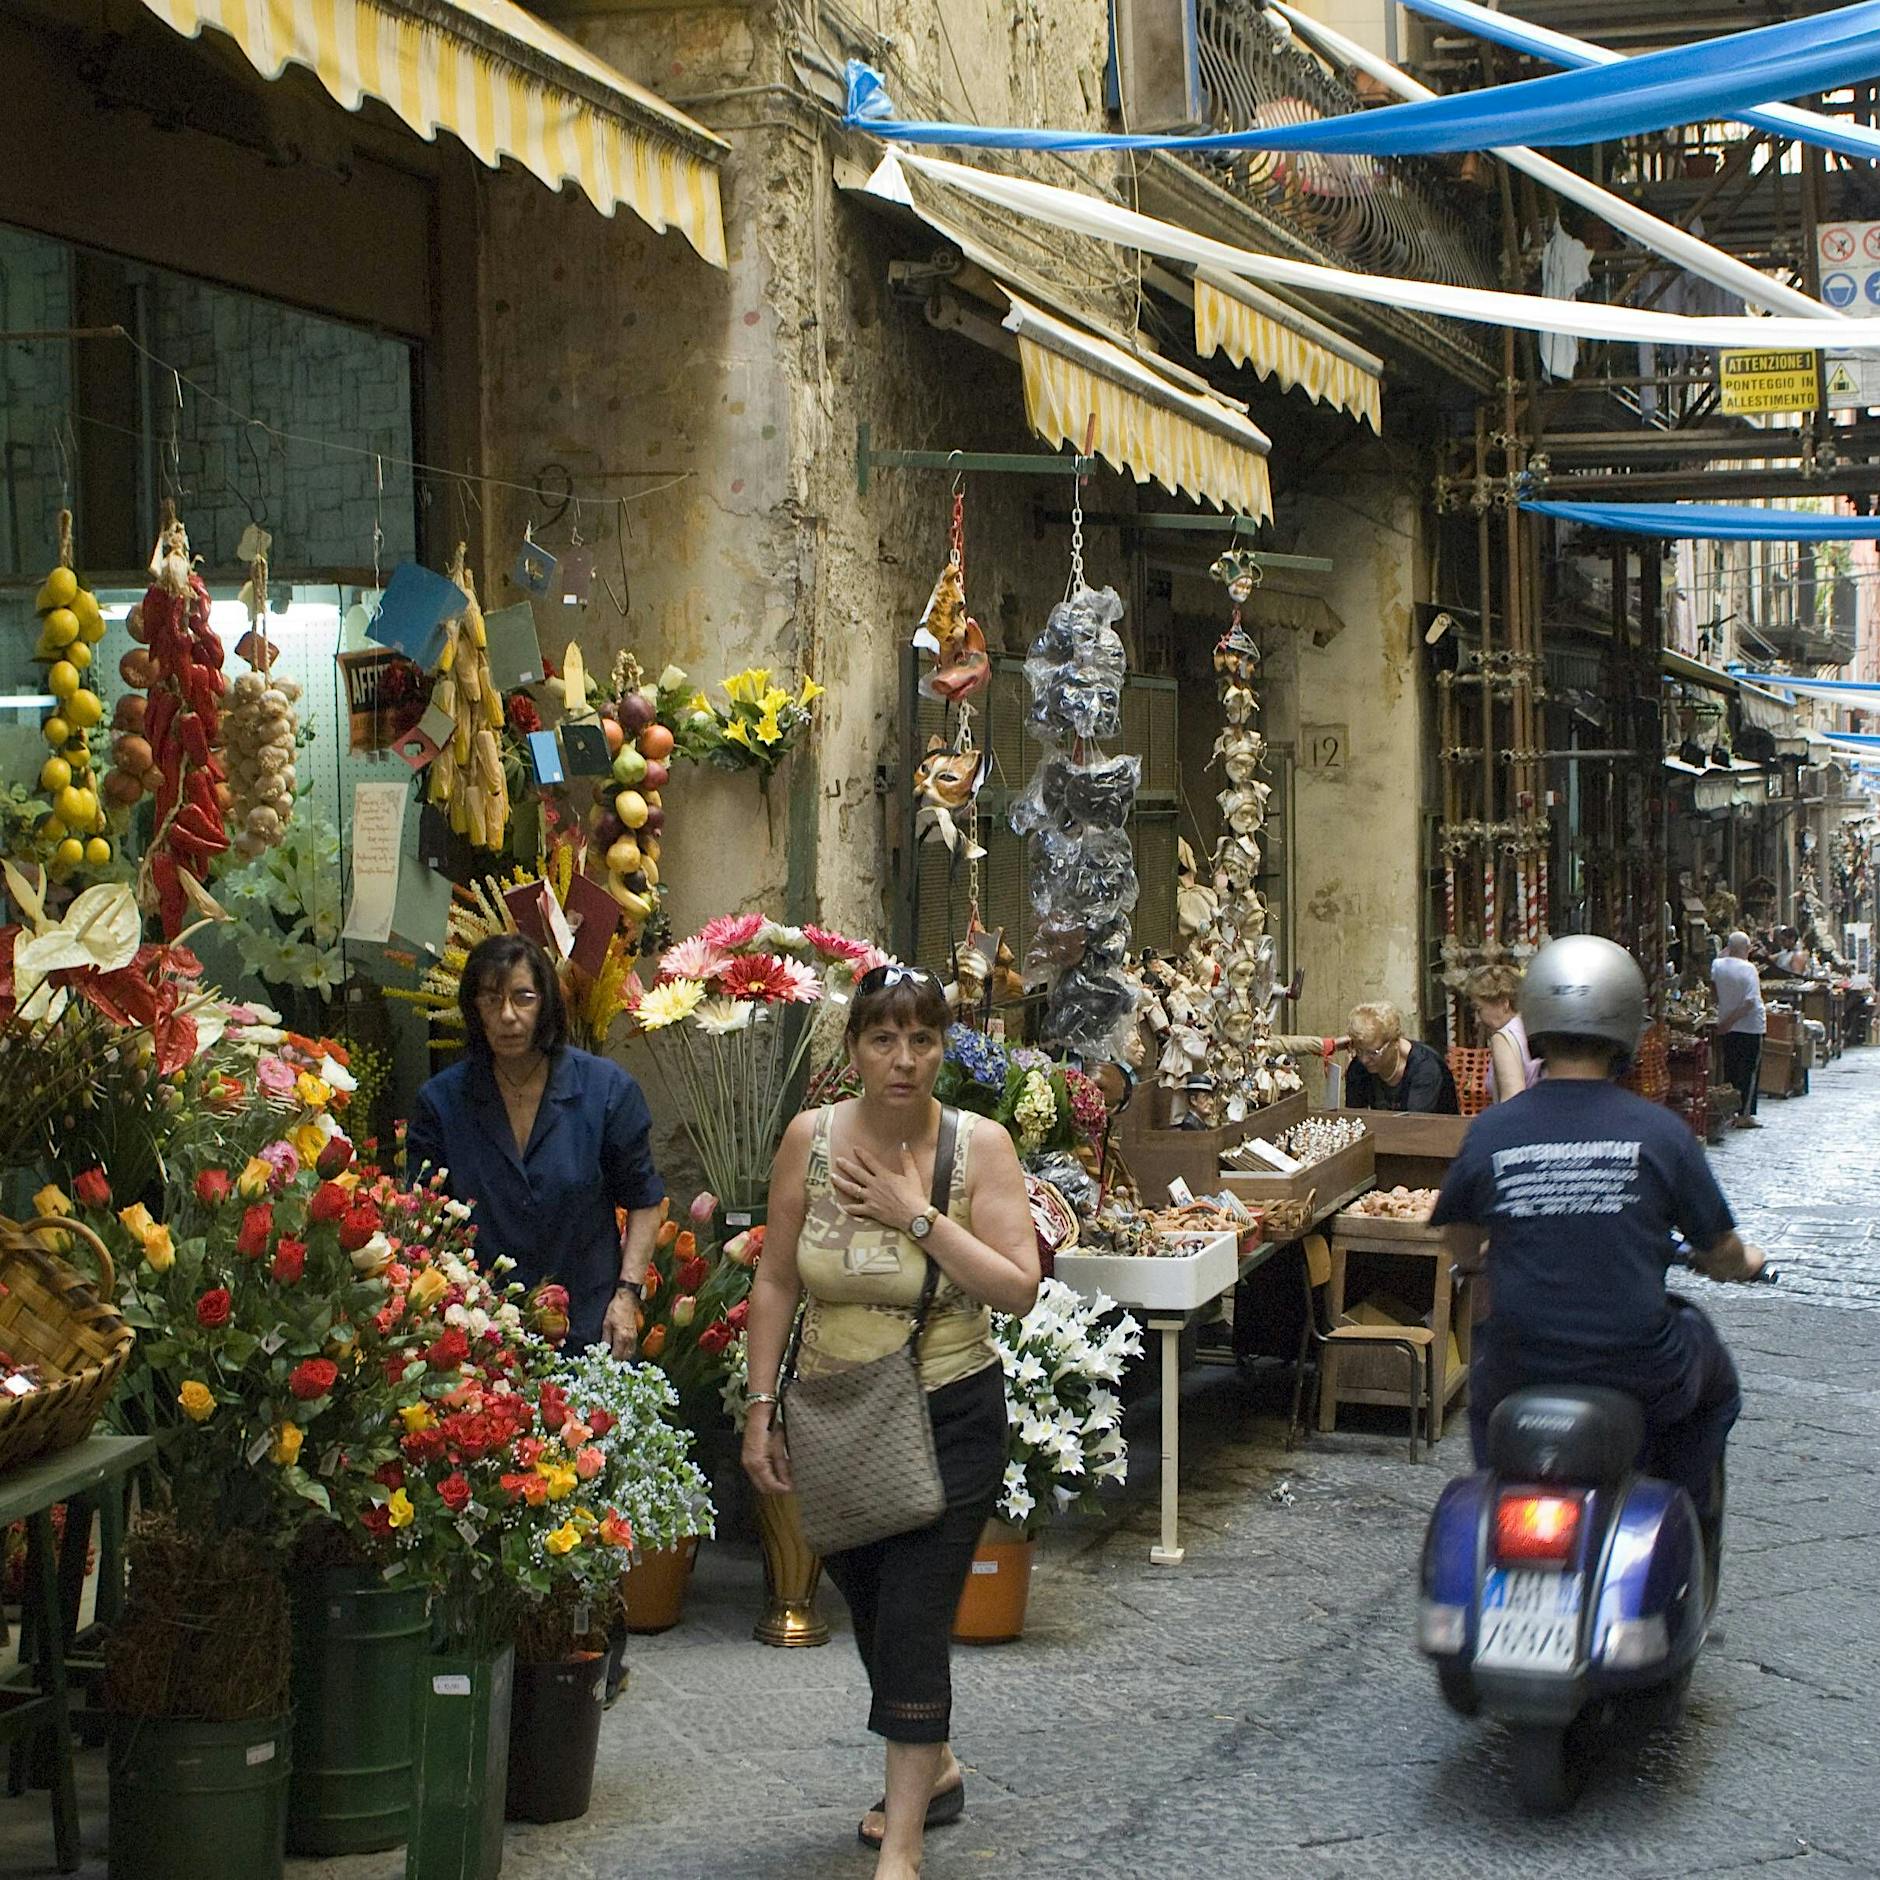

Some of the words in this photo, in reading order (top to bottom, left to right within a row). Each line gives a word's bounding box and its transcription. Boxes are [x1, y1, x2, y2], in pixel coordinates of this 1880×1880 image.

[1726, 377, 1794, 391] PONTEGGIO
[1802, 376, 1814, 387] IN
[1727, 392, 1814, 408] ALLESTIMENTO
[1313, 736, 1341, 768] 12
